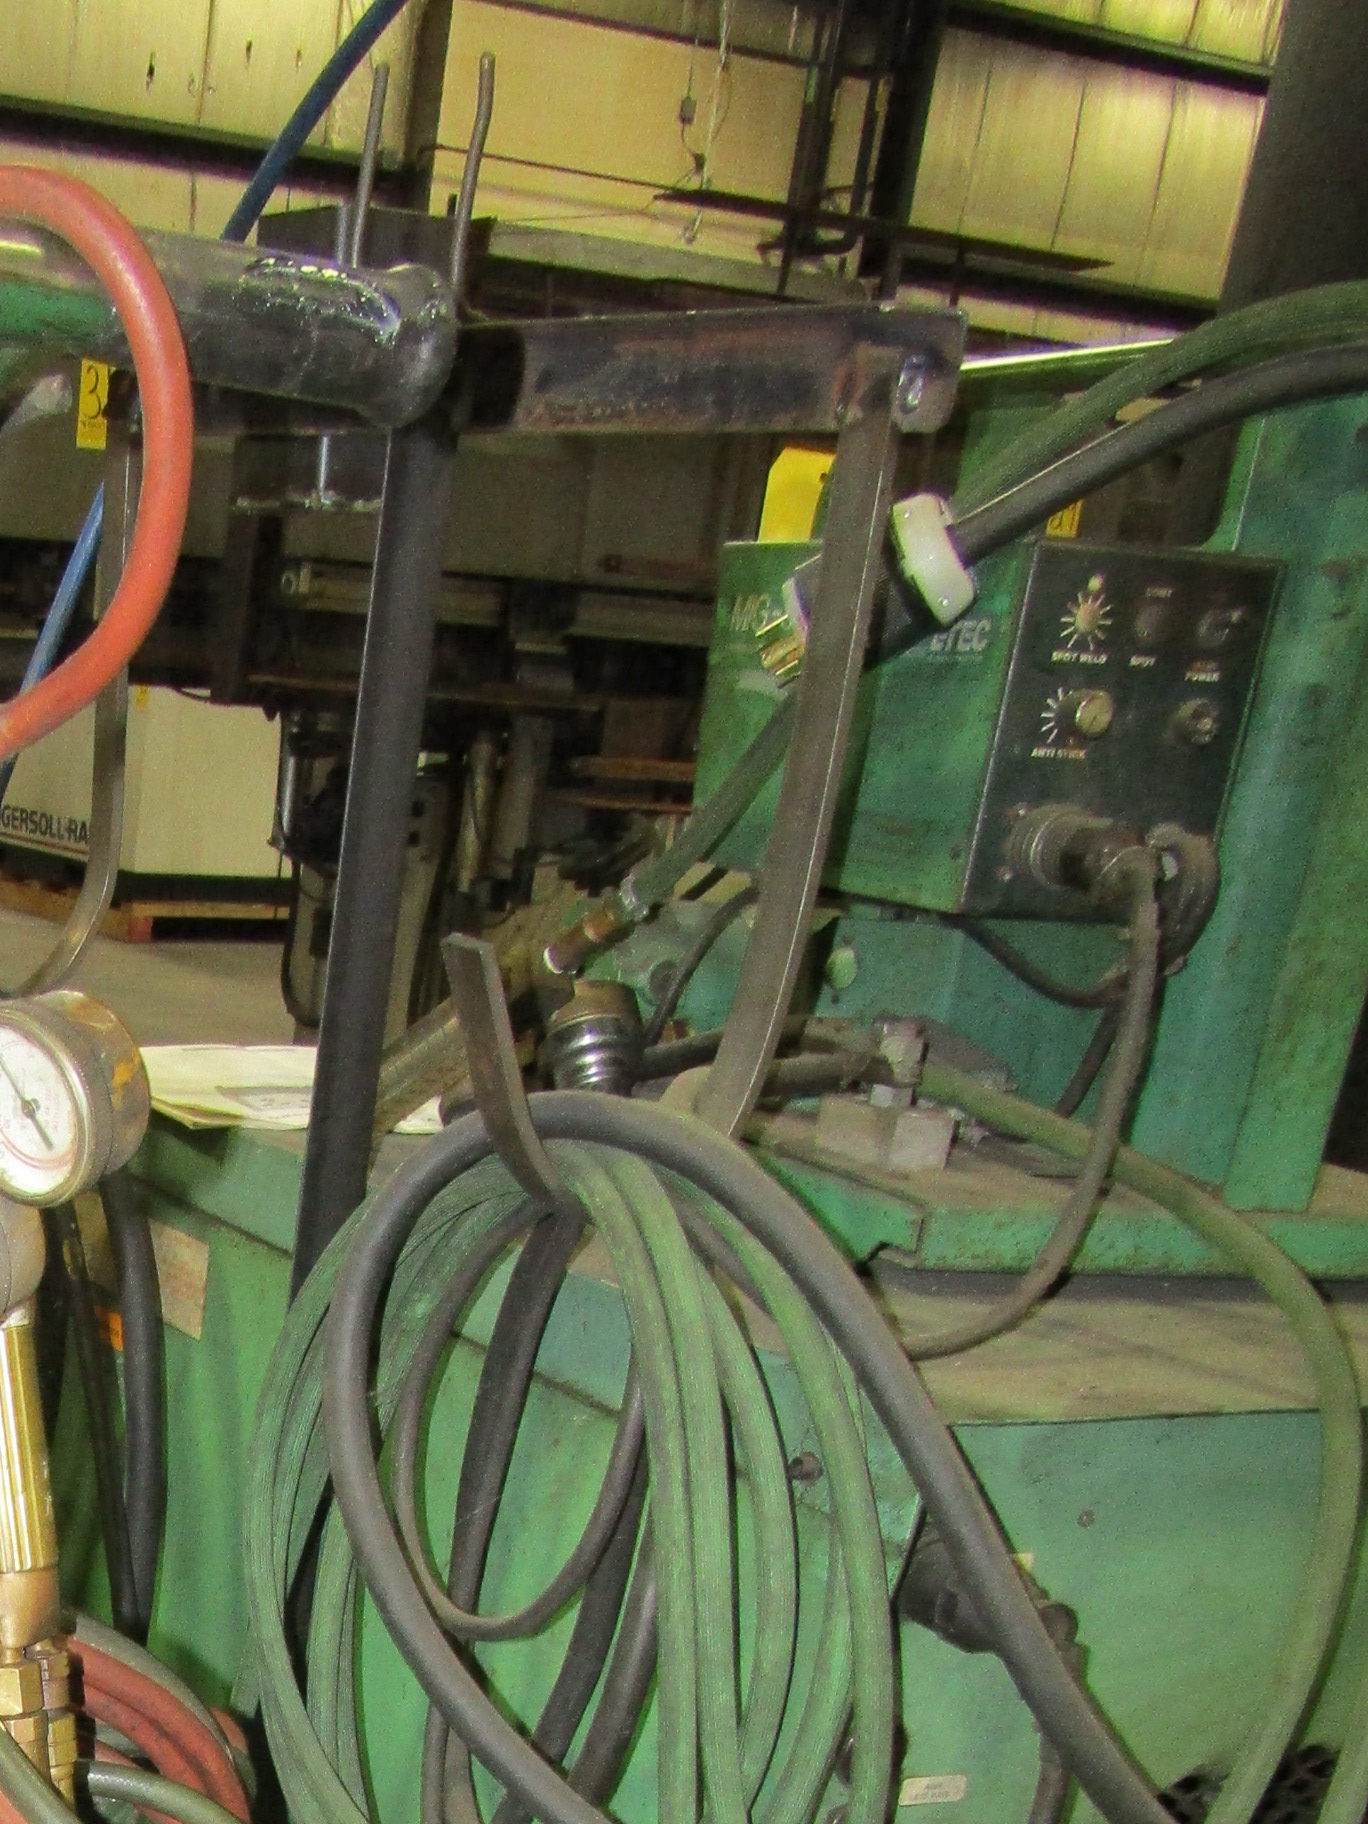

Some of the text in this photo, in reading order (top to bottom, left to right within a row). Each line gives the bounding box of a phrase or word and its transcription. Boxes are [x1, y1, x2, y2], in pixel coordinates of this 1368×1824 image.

[86, 364, 101, 420] 3
[1051, 651, 1108, 664] SPOT WELD
